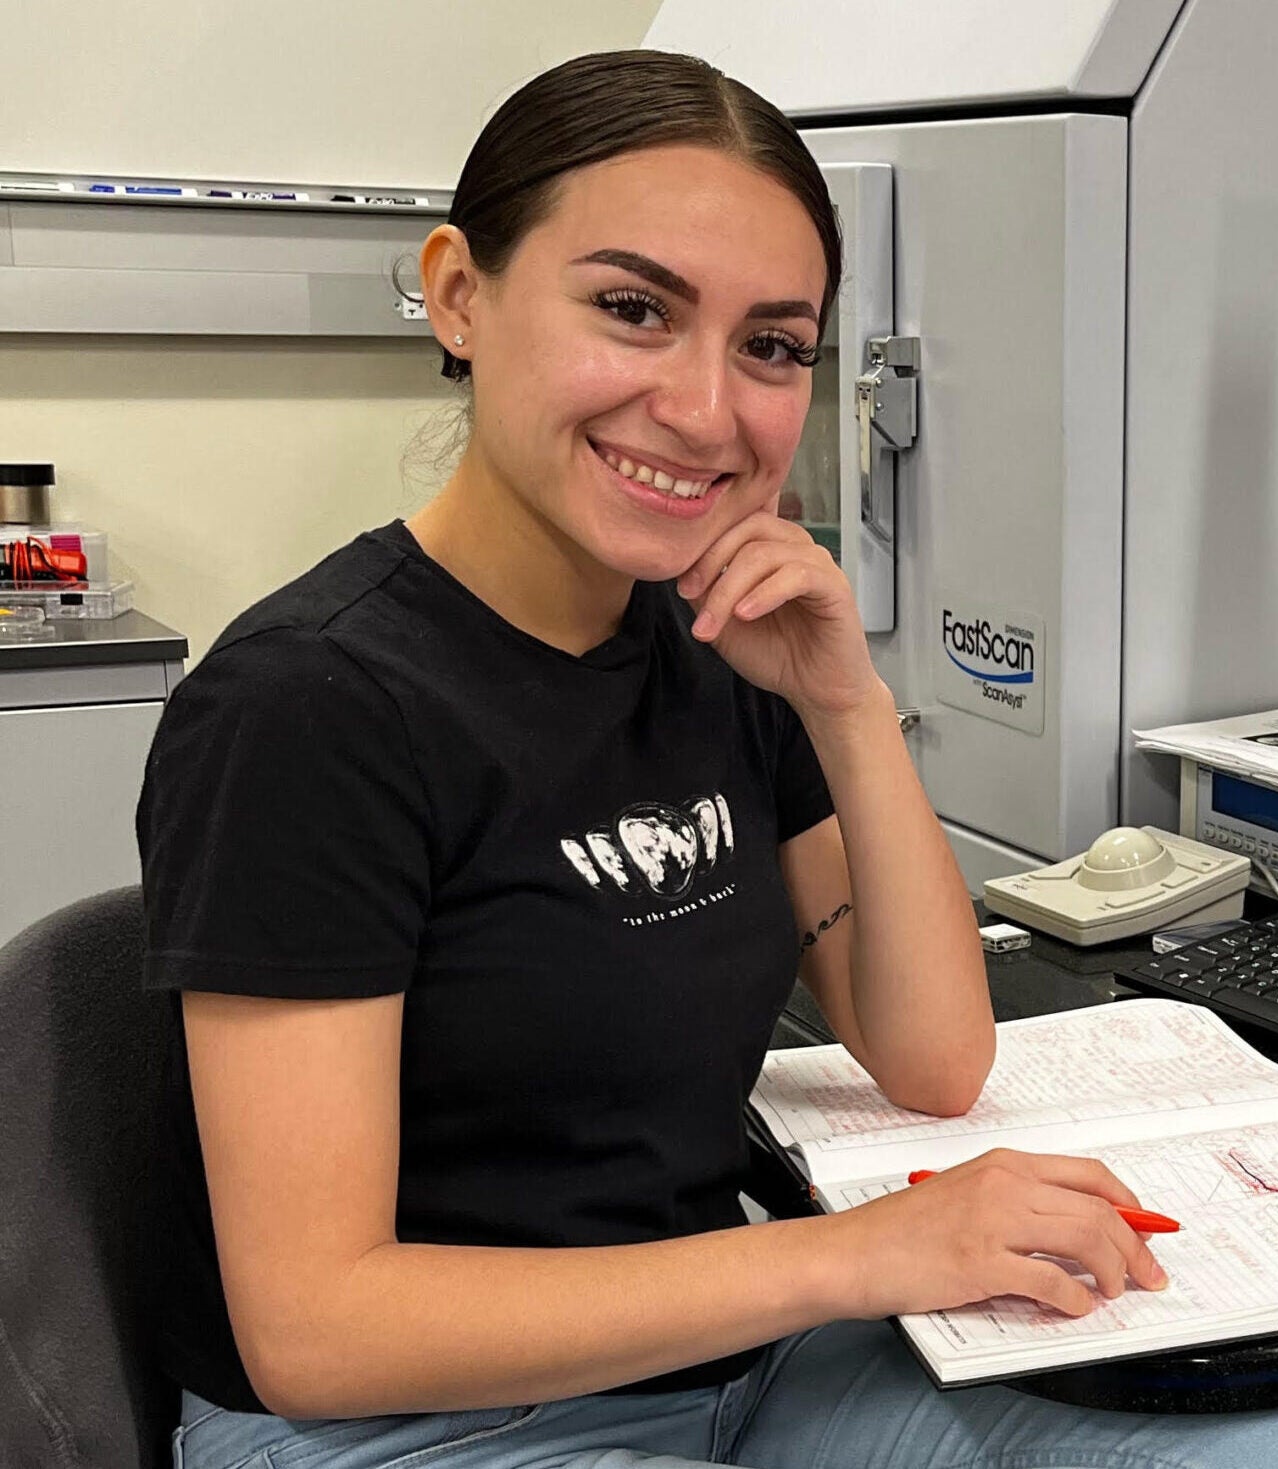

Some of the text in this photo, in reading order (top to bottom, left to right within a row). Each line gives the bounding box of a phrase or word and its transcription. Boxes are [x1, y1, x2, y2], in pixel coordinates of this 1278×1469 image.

[943, 609, 1034, 671] FastScan
[647, 912, 665, 923] the
[669, 903, 697, 917] moon
